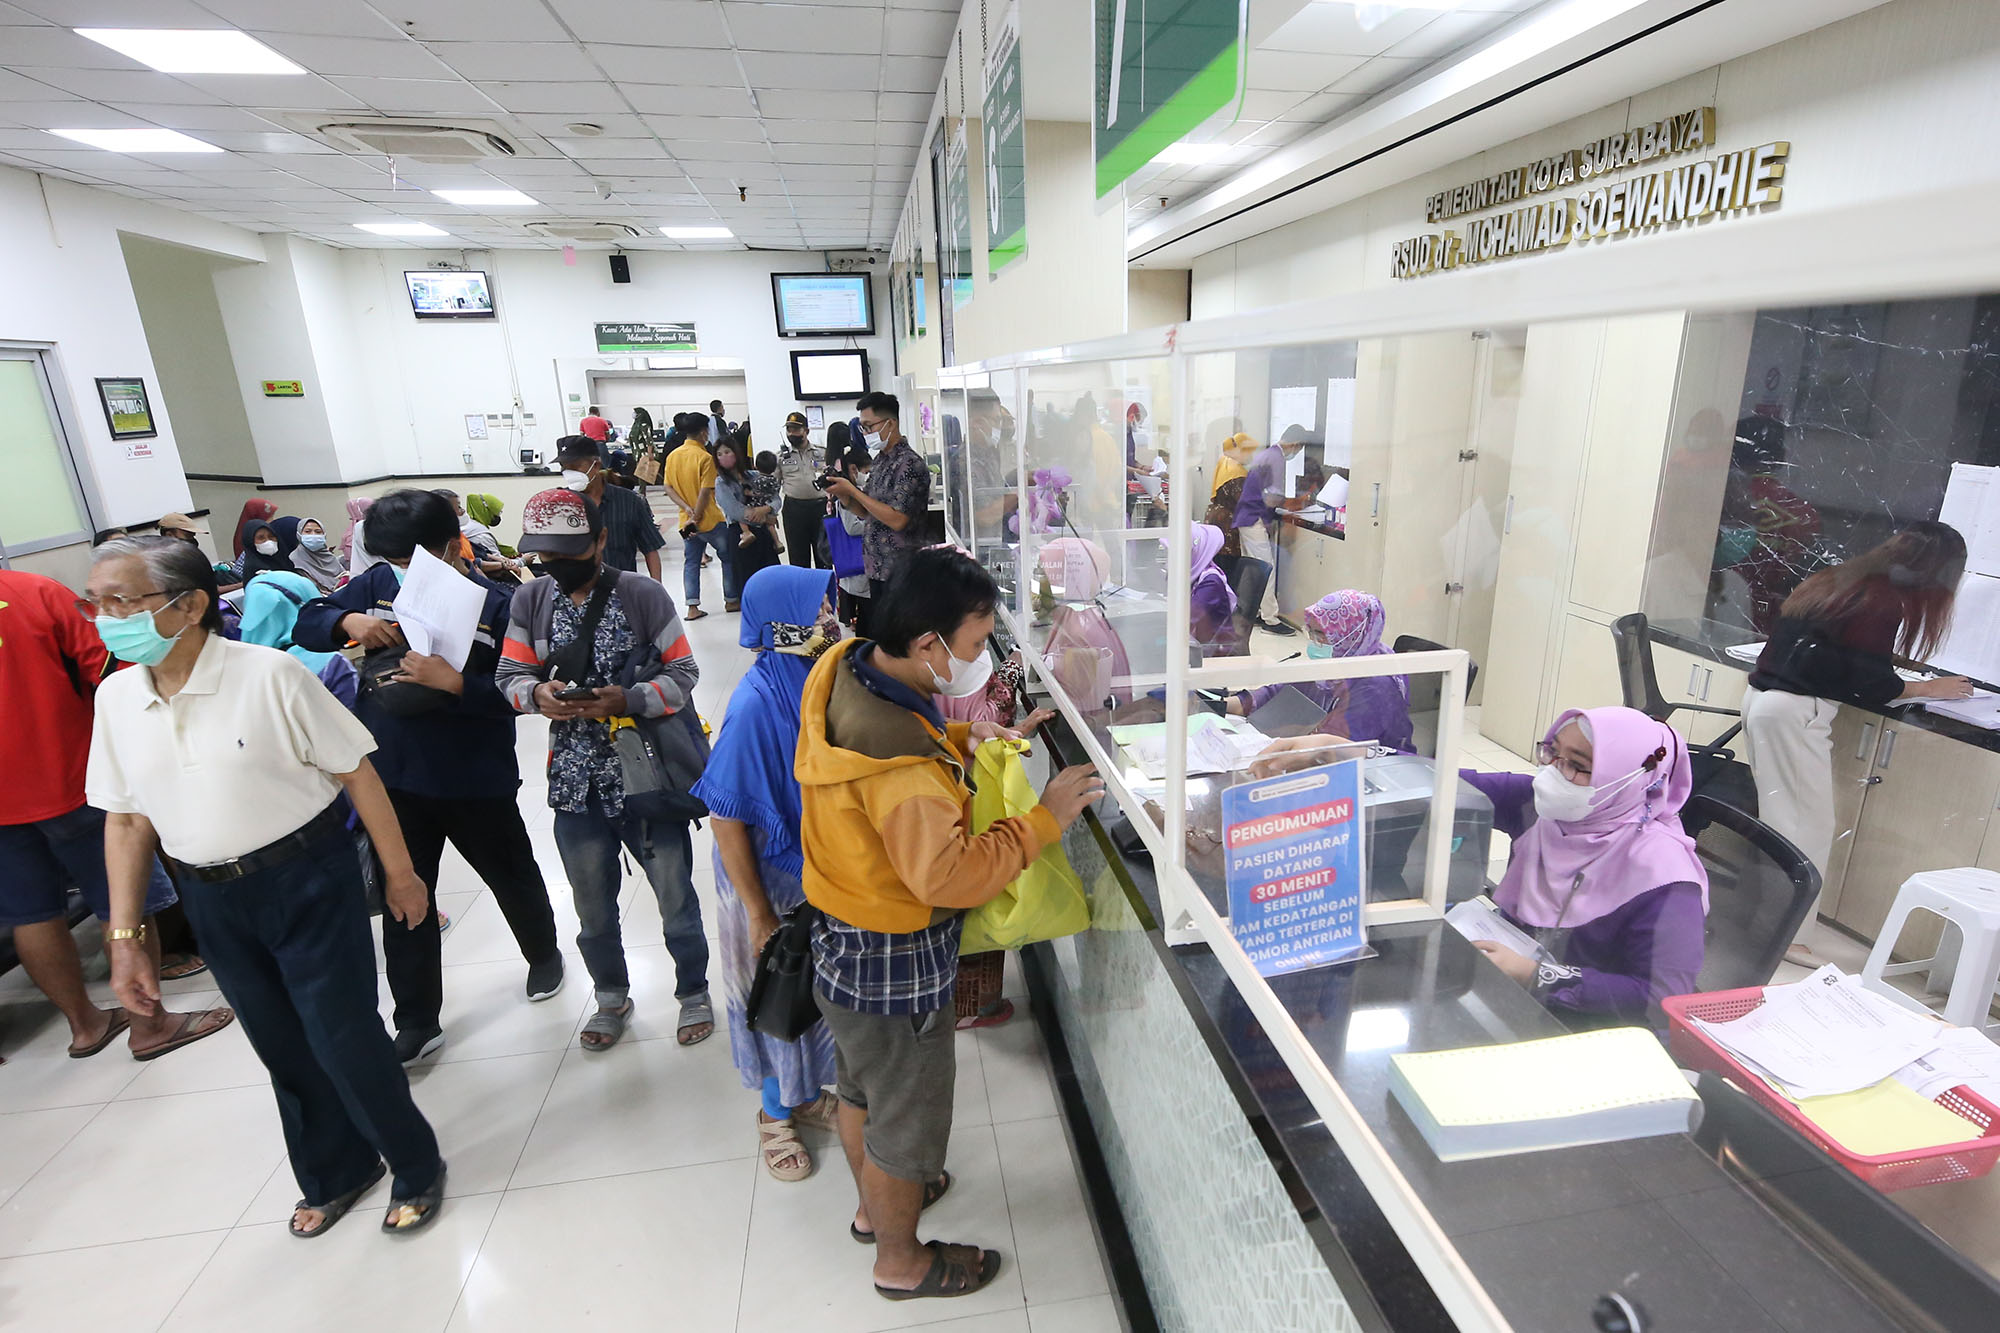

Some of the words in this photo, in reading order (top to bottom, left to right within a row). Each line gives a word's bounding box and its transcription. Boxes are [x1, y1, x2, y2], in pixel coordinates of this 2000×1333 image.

[1425, 169, 1524, 223] PEMERINTAH
[1524, 151, 1576, 195] KOTA
[1579, 106, 1709, 179] SURABAYA
[989, 125, 999, 235] 6
[1390, 234, 1435, 278] RSUD
[1465, 198, 1572, 263] MOHAMAD
[1572, 142, 1785, 241] SOEWANDHIE
[619, 325, 632, 333] Ada
[626, 333, 653, 343] Melayani
[655, 333, 677, 344] Sepenuh
[678, 333, 691, 342] Hati
[292, 382, 299, 392] 3
[1231, 803, 1349, 844] PENGUMUMAN
[1234, 849, 1285, 871] PASIEN
[1288, 833, 1350, 858] DIHARAP
[1263, 856, 1323, 879] DATANG
[1256, 884, 1277, 900] 30
[1281, 870, 1331, 894] MENIT
[1263, 889, 1325, 913] SEBELUM
[1233, 920, 1260, 937] JAM
[1263, 896, 1358, 929] KEDATANGAN
[1278, 916, 1336, 939] TERTERA
[1340, 911, 1354, 924] DI
[1247, 943, 1290, 964] OMOR
[1293, 926, 1353, 952] ANTRIAN
[1274, 950, 1322, 969] ONLINE
